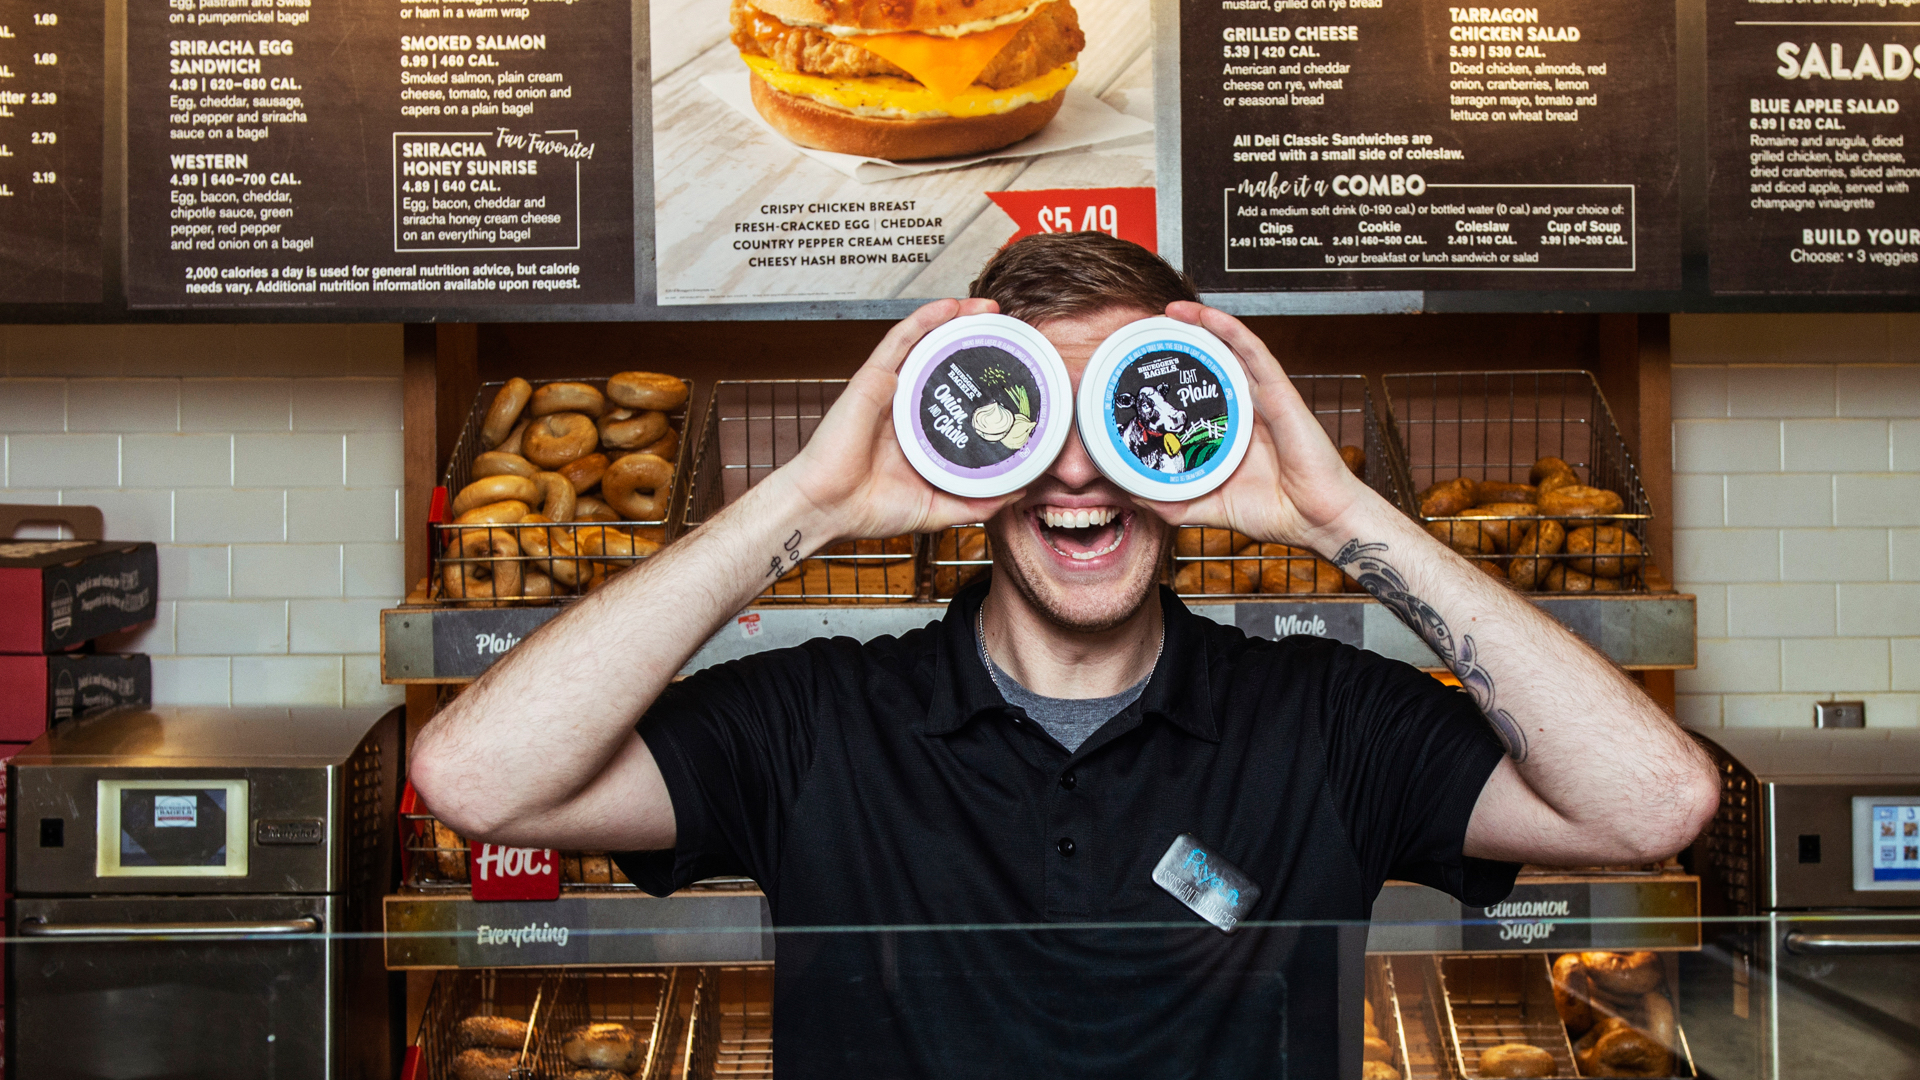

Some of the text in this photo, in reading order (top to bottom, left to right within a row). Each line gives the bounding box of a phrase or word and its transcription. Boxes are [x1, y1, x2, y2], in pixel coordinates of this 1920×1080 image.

[33, 13, 57, 25] 1.69
[1448, 7, 1538, 23] TARRAGON
[1222, 25, 1358, 42] GRILLED CHEESE
[1449, 25, 1580, 41] CHICKEN SALAD
[170, 39, 293, 55] SRIRACHA EGG
[400, 35, 545, 51] SMOKED SALMON
[33, 52, 57, 65] 1.69
[1223, 45, 1320, 58] 5.39 420 CAL.
[1449, 45, 1546, 58] 5.99 530 CAL.
[170, 58, 260, 74] SANDWICH
[400, 54, 499, 67] 6.99 460 CAL.
[1222, 62, 1350, 75] American and cheddar
[169, 78, 198, 90] 4.89
[270, 77, 302, 90] CAL.
[31, 92, 57, 104] 2.39
[170, 94, 304, 110] Egg, cheddar, sausage,
[1750, 98, 1899, 113] BLUE APPLE SALAD
[1749, 117, 1845, 130] 6.99 620 CAL.
[31, 131, 56, 144] 2.79
[496, 126, 595, 160] Fan Favorite!
[1233, 133, 1432, 146] All Deli Classic Sandwiches are
[402, 141, 486, 157] SRIRACHA
[1233, 147, 1464, 161] served with a small side of coleslaw.
[170, 153, 248, 169] WESTERN
[403, 159, 537, 176] HONEY SUNRISE
[32, 171, 56, 183] 3.19
[169, 173, 198, 186] 4.99
[270, 172, 301, 185] CAL.
[402, 179, 501, 192] 4.89 640 CAL.
[1238, 171, 1428, 199] make it a COMBO
[760, 200, 915, 214] CRISPY CHICKEN BREAST
[1750, 196, 1875, 211] champagne vinaigrette
[734, 217, 942, 232] FRESH-CRACKED EGG CHEDDAR
[1259, 222, 1294, 235] Chips
[1358, 220, 1401, 232] Cookie
[1455, 220, 1509, 232] Coleslaw
[1546, 220, 1621, 235] Cup of Soup
[732, 234, 946, 250] COUNTRY PEPPER CREAM CHEESE
[1230, 237, 1251, 246] 2.49
[1299, 236, 1323, 246] CAL.
[1332, 236, 1353, 245] 2.49
[1404, 235, 1427, 244] CAL.
[1447, 234, 1517, 245] 2.49 140 CAL.
[1540, 235, 1561, 244] 3.99
[1605, 235, 1627, 244] CAL.
[1802, 228, 1920, 245] BUILD YOUR
[748, 252, 931, 267] CHEESY HASH BROWN BAGEL
[1790, 248, 1918, 266] Choose: 3 veggies
[185, 262, 580, 280] 2,000 calories a day is used for general nutrition advice, but calorie
[186, 277, 580, 295] needs vary. Additional nutrition information available upon request.
[1137, 358, 1180, 374] BRUEGGER'S
[1180, 368, 1198, 384] LIGHT
[1176, 380, 1218, 408] Plain
[928, 404, 942, 418] AND
[934, 384, 968, 424] Onion
[933, 414, 969, 448] Chive
[1274, 614, 1326, 636] Whole
[476, 843, 552, 882] Hot!
[1156, 867, 1238, 931] ASSISTANT MANAGER
[476, 922, 569, 948] Everything
[1498, 920, 1555, 944] Sugar
